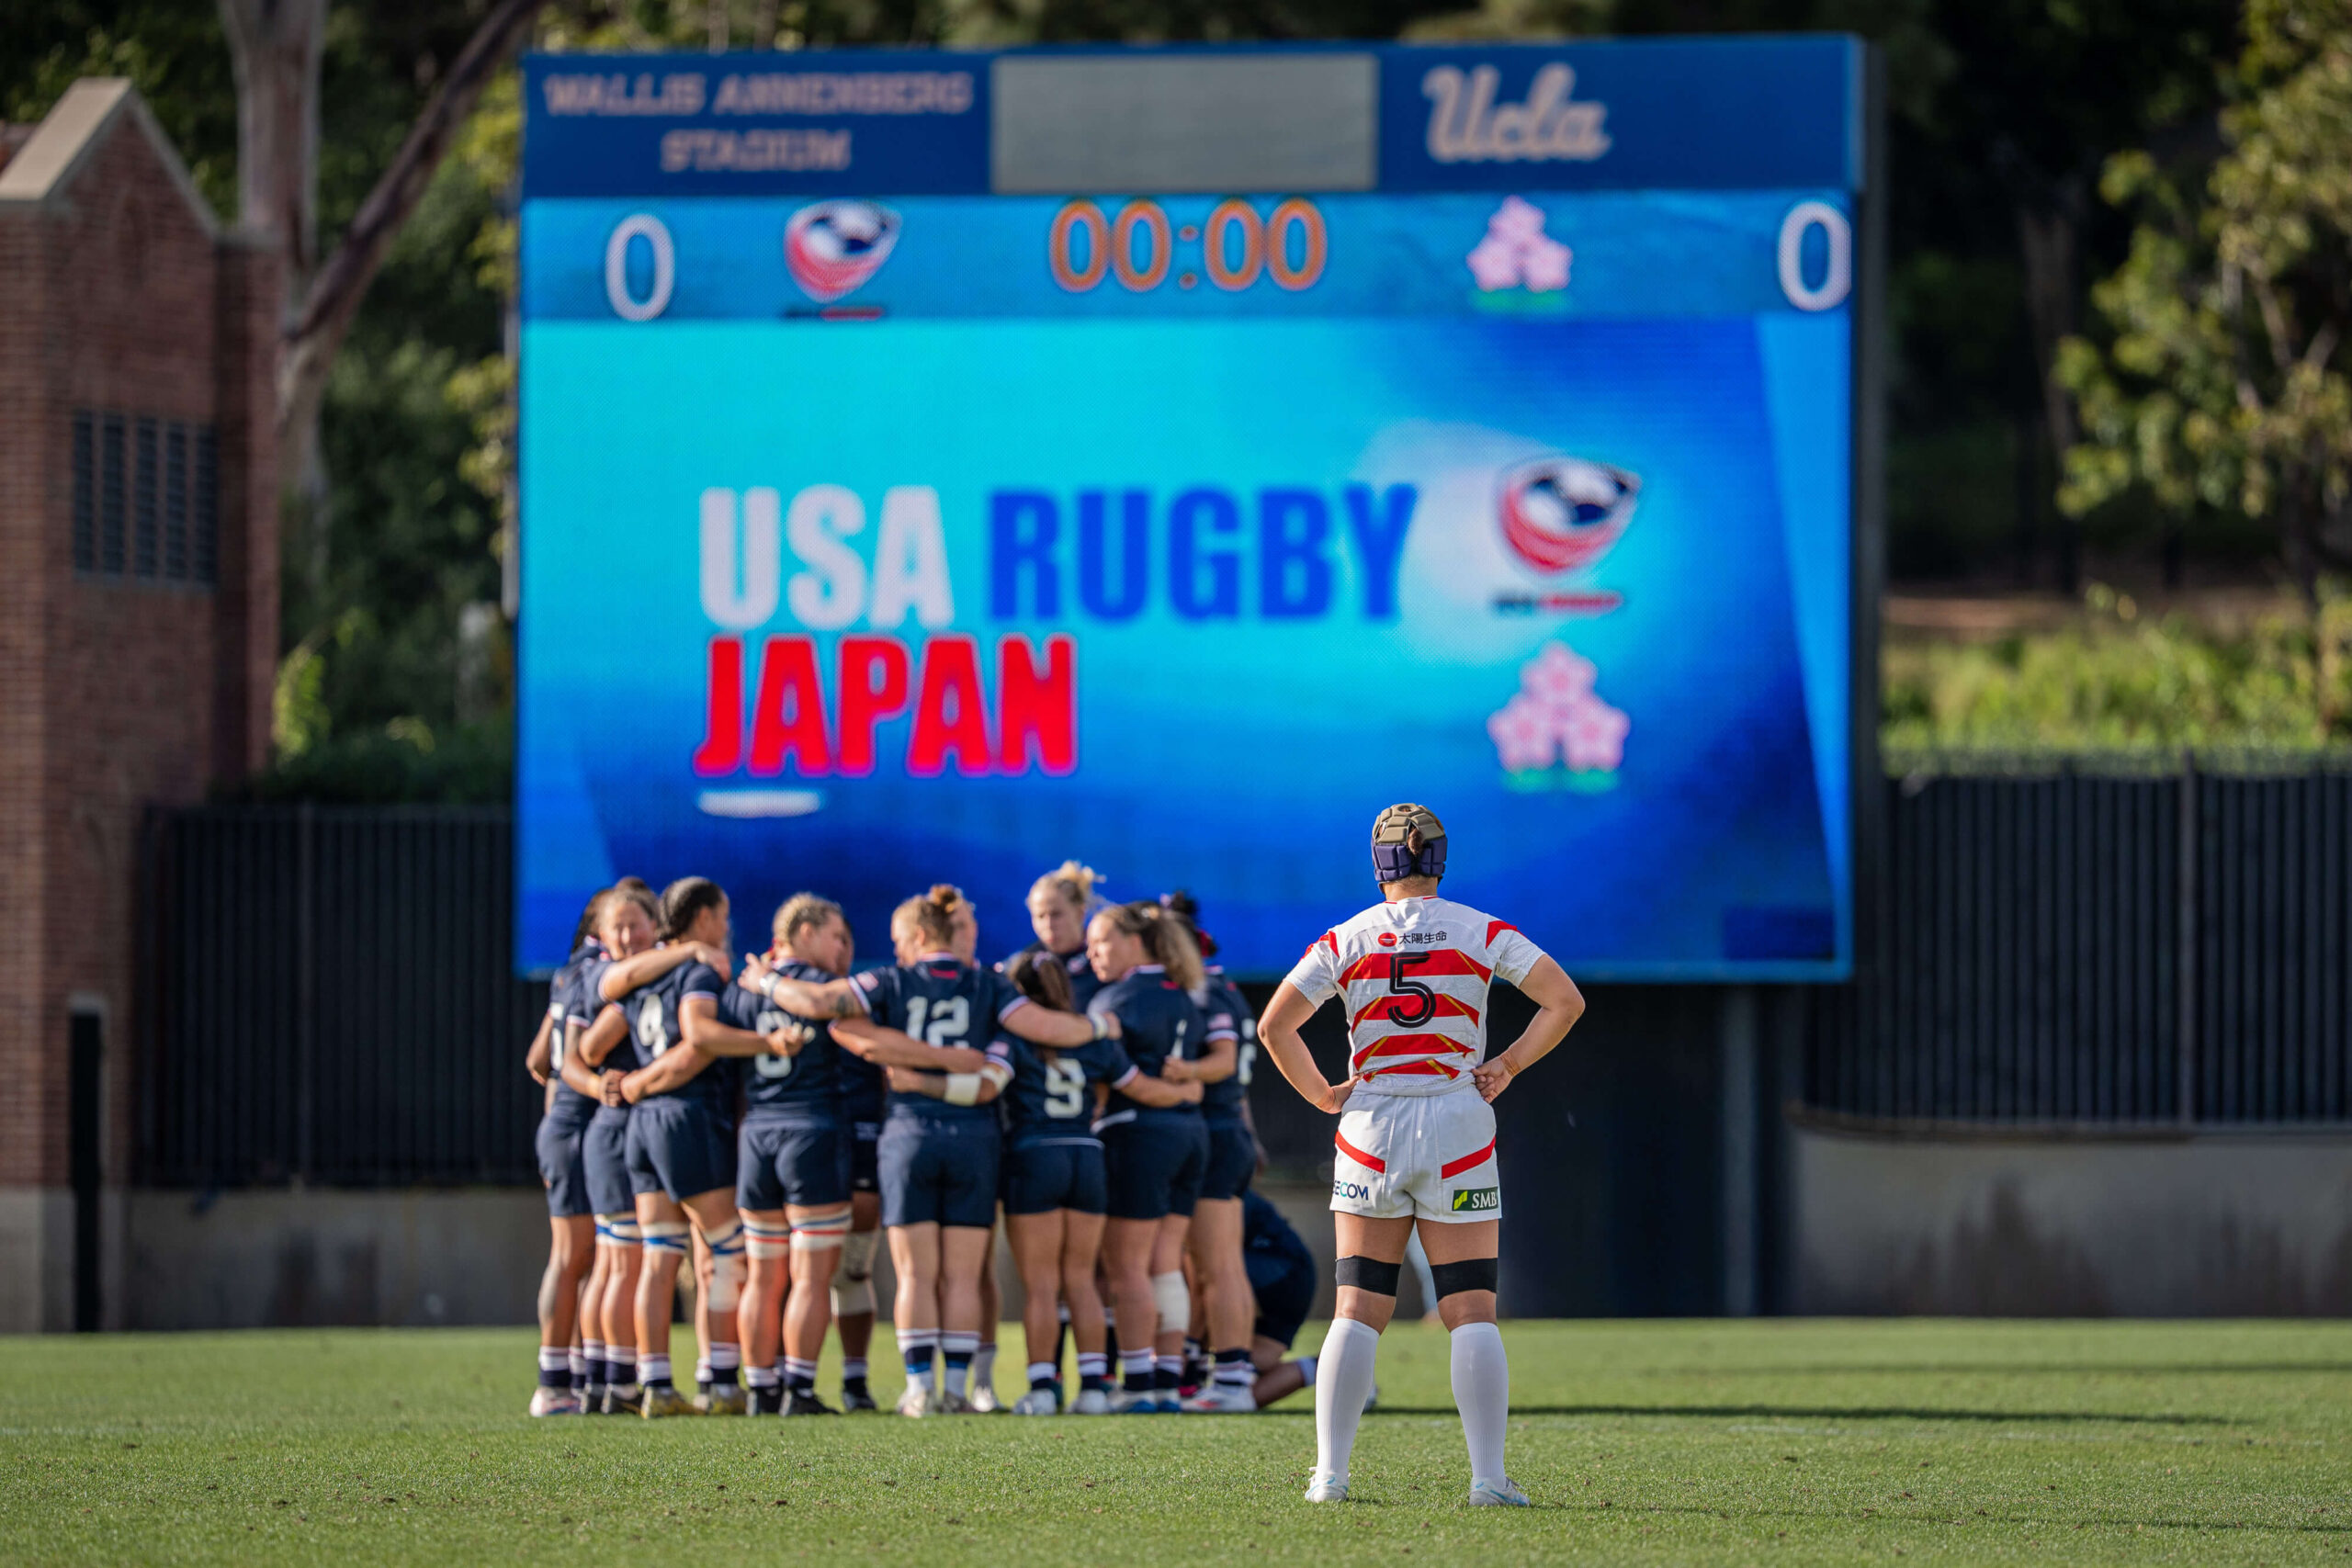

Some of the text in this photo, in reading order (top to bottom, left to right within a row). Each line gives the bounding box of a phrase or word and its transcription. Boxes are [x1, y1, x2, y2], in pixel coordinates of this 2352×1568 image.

[543, 72, 975, 115] WALLIS ANNENBERG
[660, 129, 852, 173] STADIUM
[605, 213, 676, 322] 0
[1048, 197, 1329, 293] 00:00
[1777, 200, 1852, 311] 0
[699, 481, 1420, 630] USA RUGBY
[692, 632, 1080, 779] JAPAN
[1399, 931, 1447, 944] 太陽生命
[906, 995, 970, 1049] 12
[1386, 951, 1437, 1029] 5
[1043, 1058, 1086, 1119] 9
[1472, 1190, 1498, 1209] SMB
